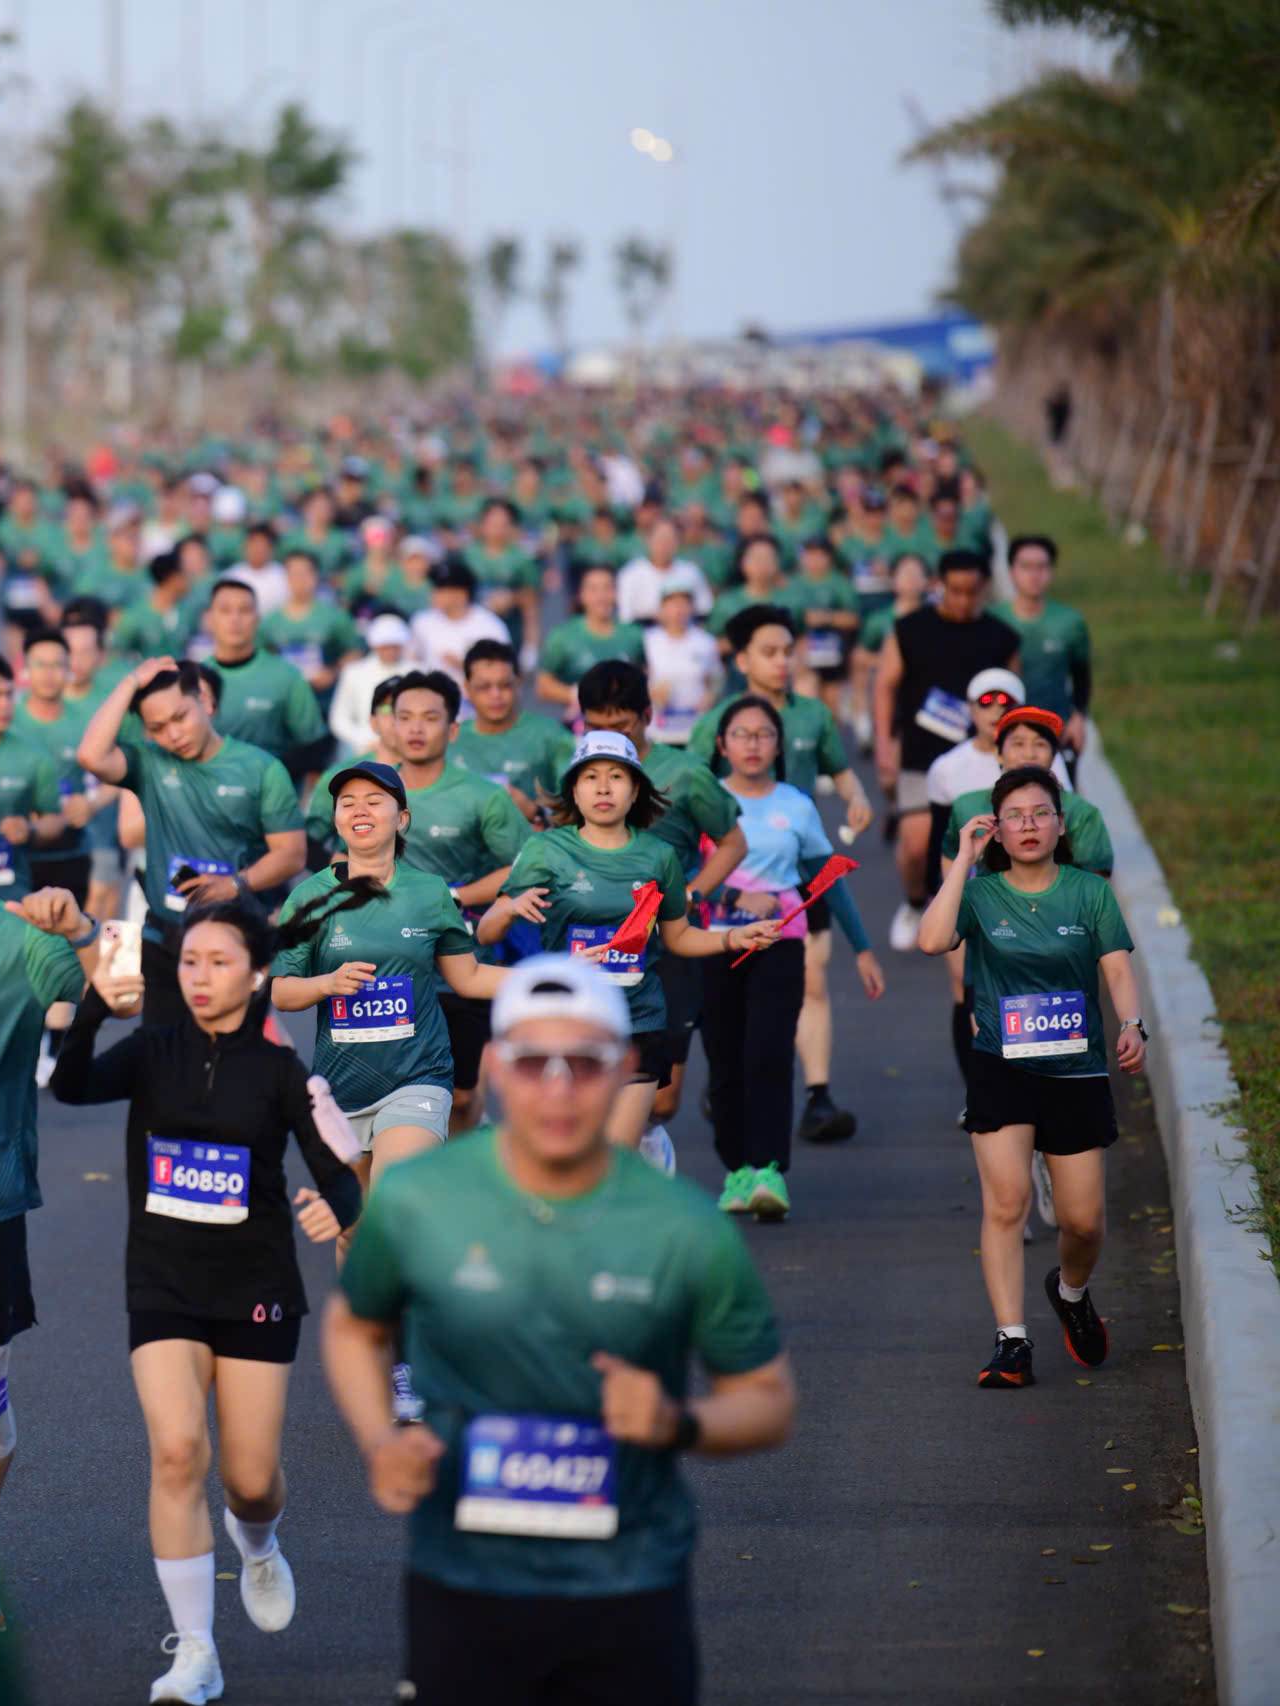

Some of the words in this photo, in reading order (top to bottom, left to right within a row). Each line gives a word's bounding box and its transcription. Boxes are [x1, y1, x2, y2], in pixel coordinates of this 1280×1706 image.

[352, 998, 407, 1018] 61230
[1024, 1012, 1083, 1032] 60469
[173, 1165, 244, 1195] 60850
